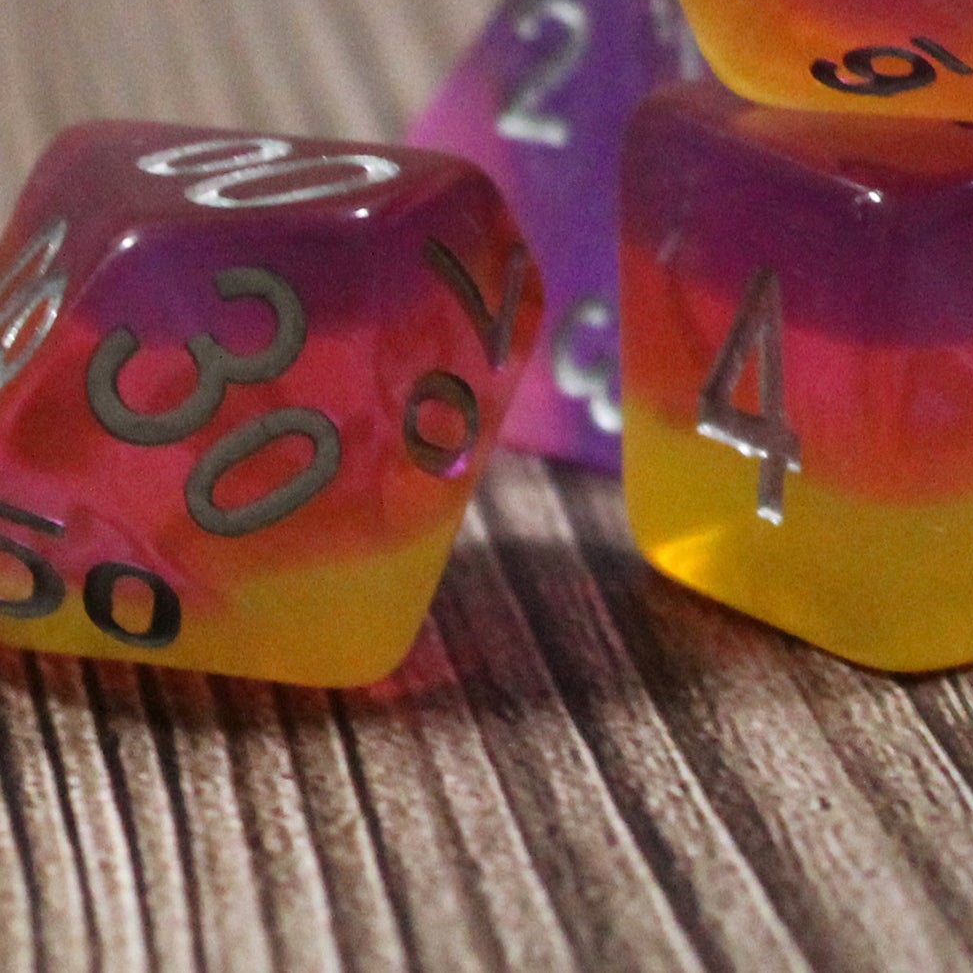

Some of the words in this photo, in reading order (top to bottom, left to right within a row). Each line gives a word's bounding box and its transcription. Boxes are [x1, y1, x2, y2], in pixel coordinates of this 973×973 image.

[136, 137, 401, 209] 00
[86, 266, 342, 538] 30
[403, 235, 528, 479] 70
[697, 265, 800, 527] 4
